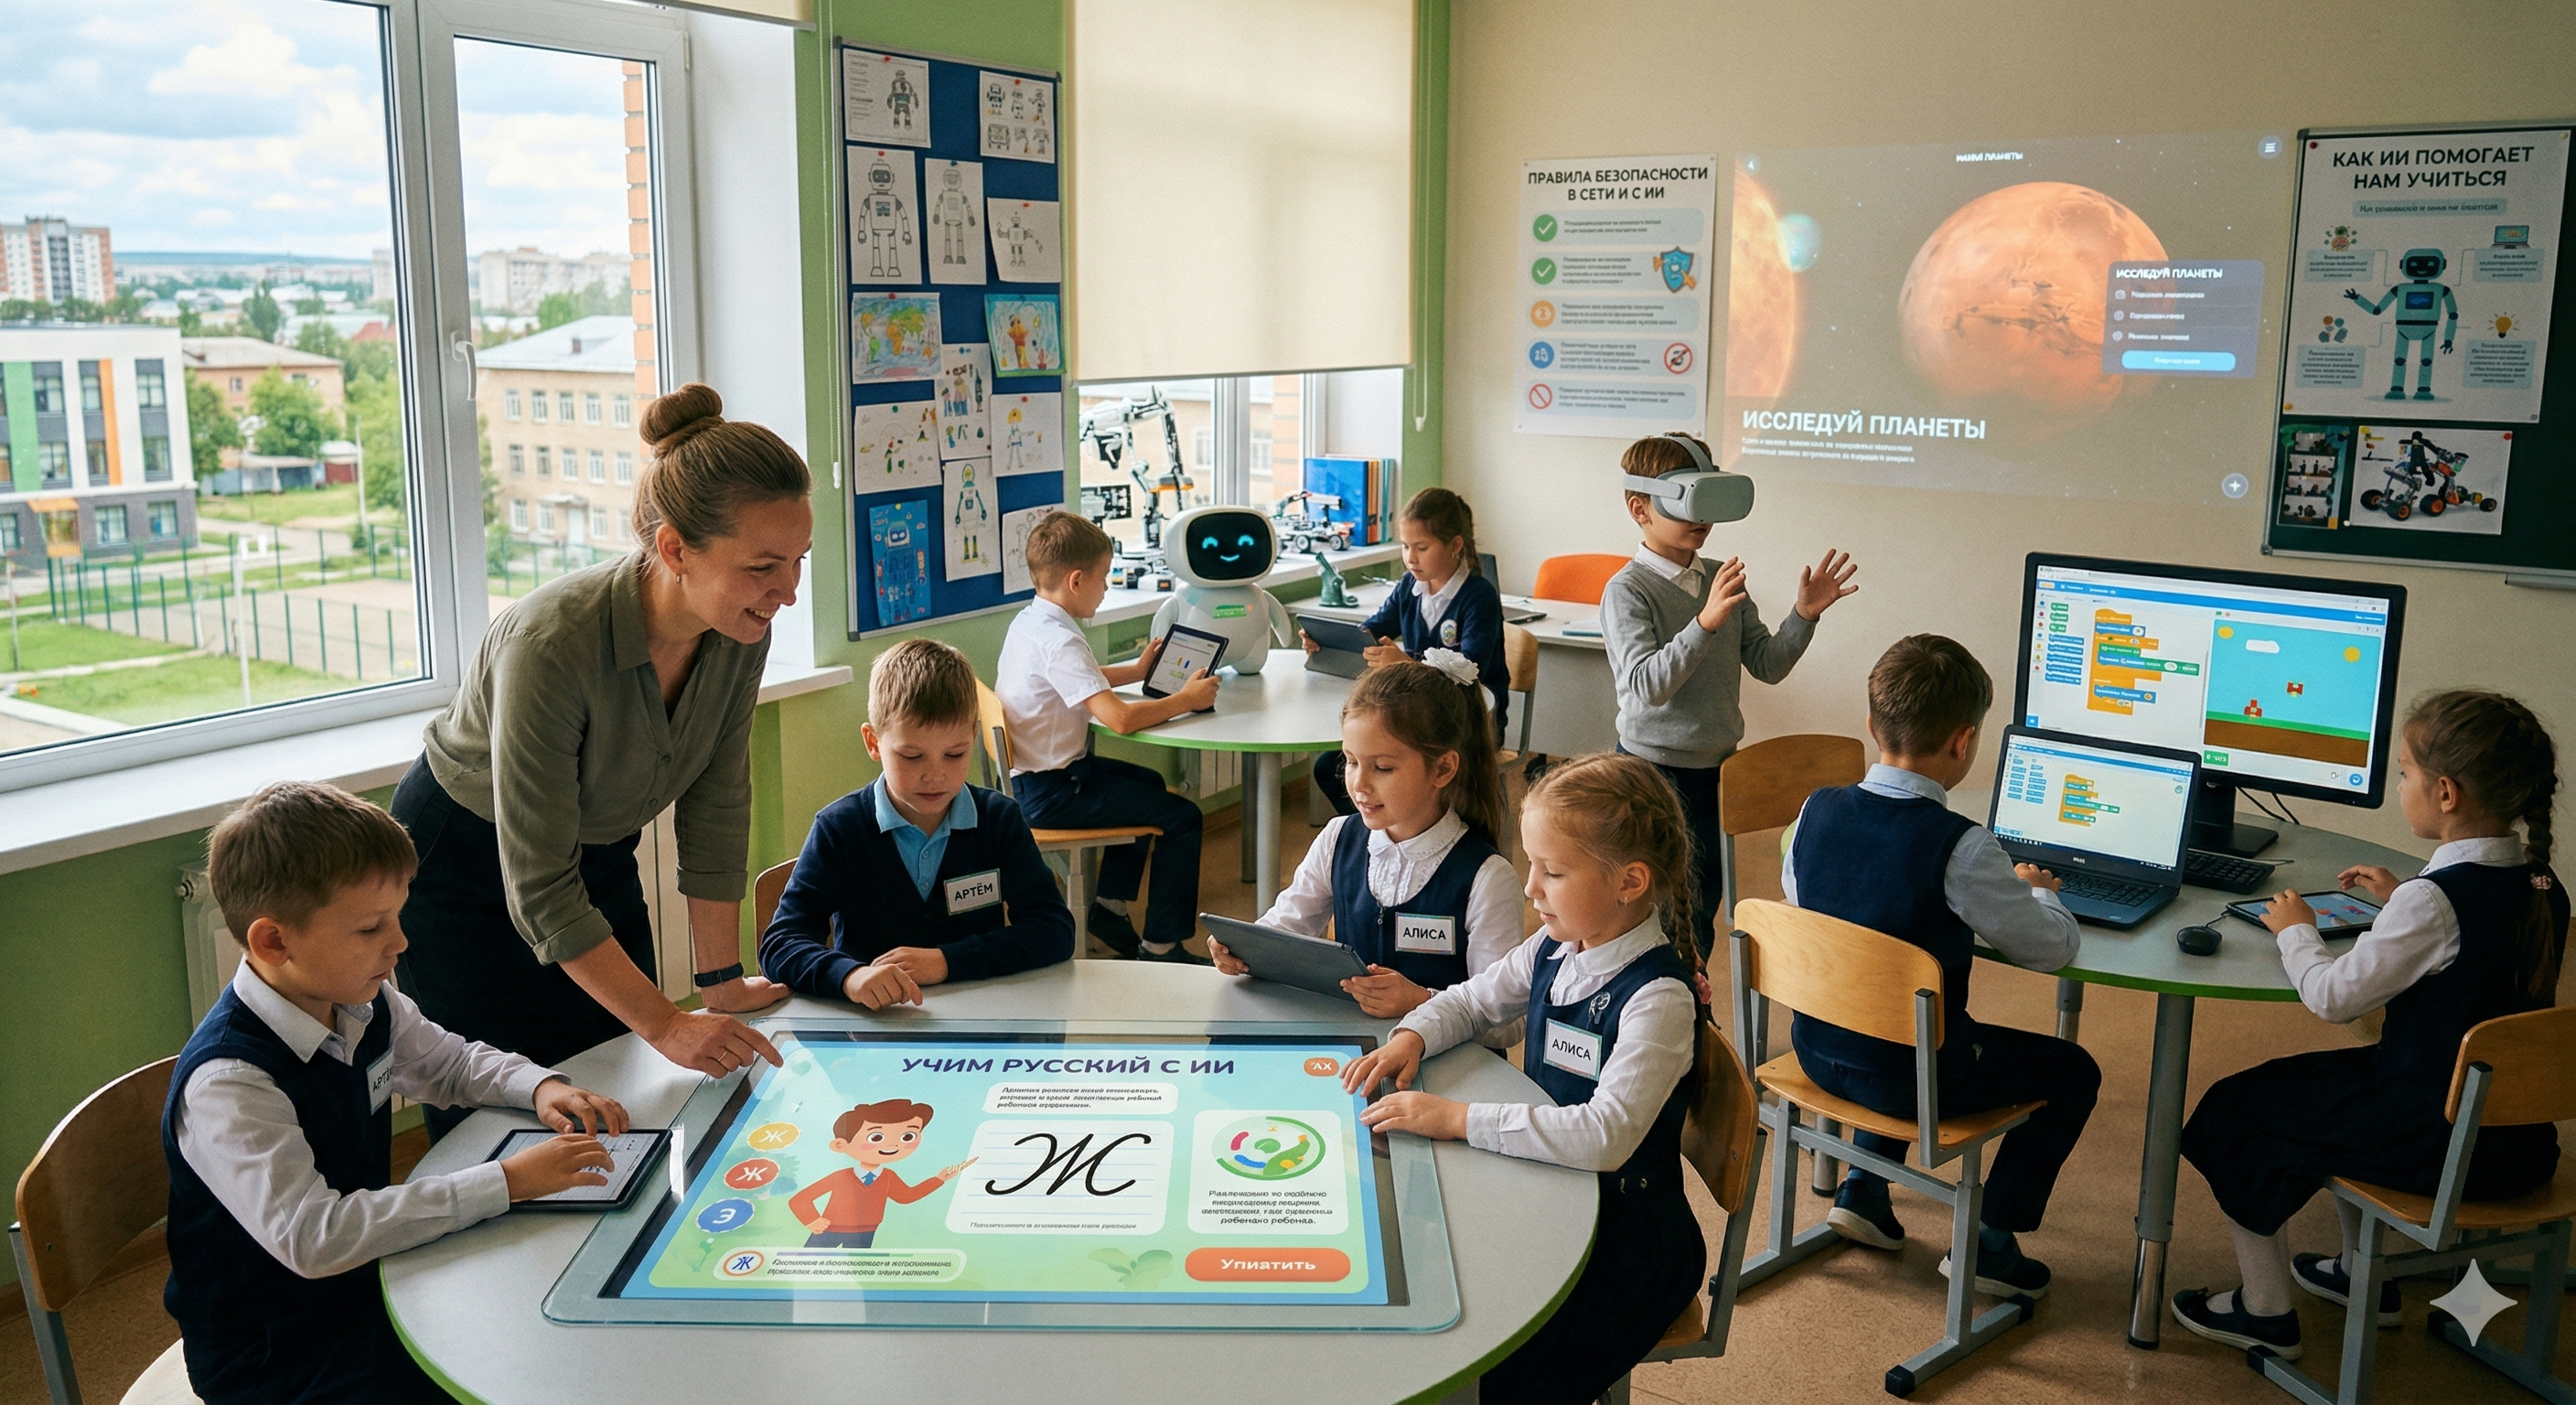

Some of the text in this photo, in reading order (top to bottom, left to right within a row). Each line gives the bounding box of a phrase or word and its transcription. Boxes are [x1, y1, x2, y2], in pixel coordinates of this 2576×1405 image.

[2333, 146, 2535, 167] КАК ИИ ПОМОГАЕТ
[1528, 167, 1708, 184] ПРАВИЛА БЕЗОПАСНОСТИ
[2354, 170, 2506, 189] НАМ УЧИТЬСЯ
[1568, 187, 1665, 200] В СЕТИ И С ИИ
[2116, 267, 2223, 280] ИССЛЕДУЙ ПЛАНЕТЫ
[1743, 409, 1986, 439] ИССЛЕДУЙ ПЛАНЕТЫ
[954, 882, 993, 902] АРТЁМ
[1402, 927, 1447, 940] АЛИСА
[1551, 1038, 1591, 1061] АЛИСА
[902, 1056, 1234, 1074] УЧИМ РУССКИЙ С ИИ
[758, 1129, 789, 1143] Ж
[735, 1166, 768, 1183] Ж
[712, 1207, 736, 1225] Э
[1220, 1259, 1316, 1271] Упиатить
